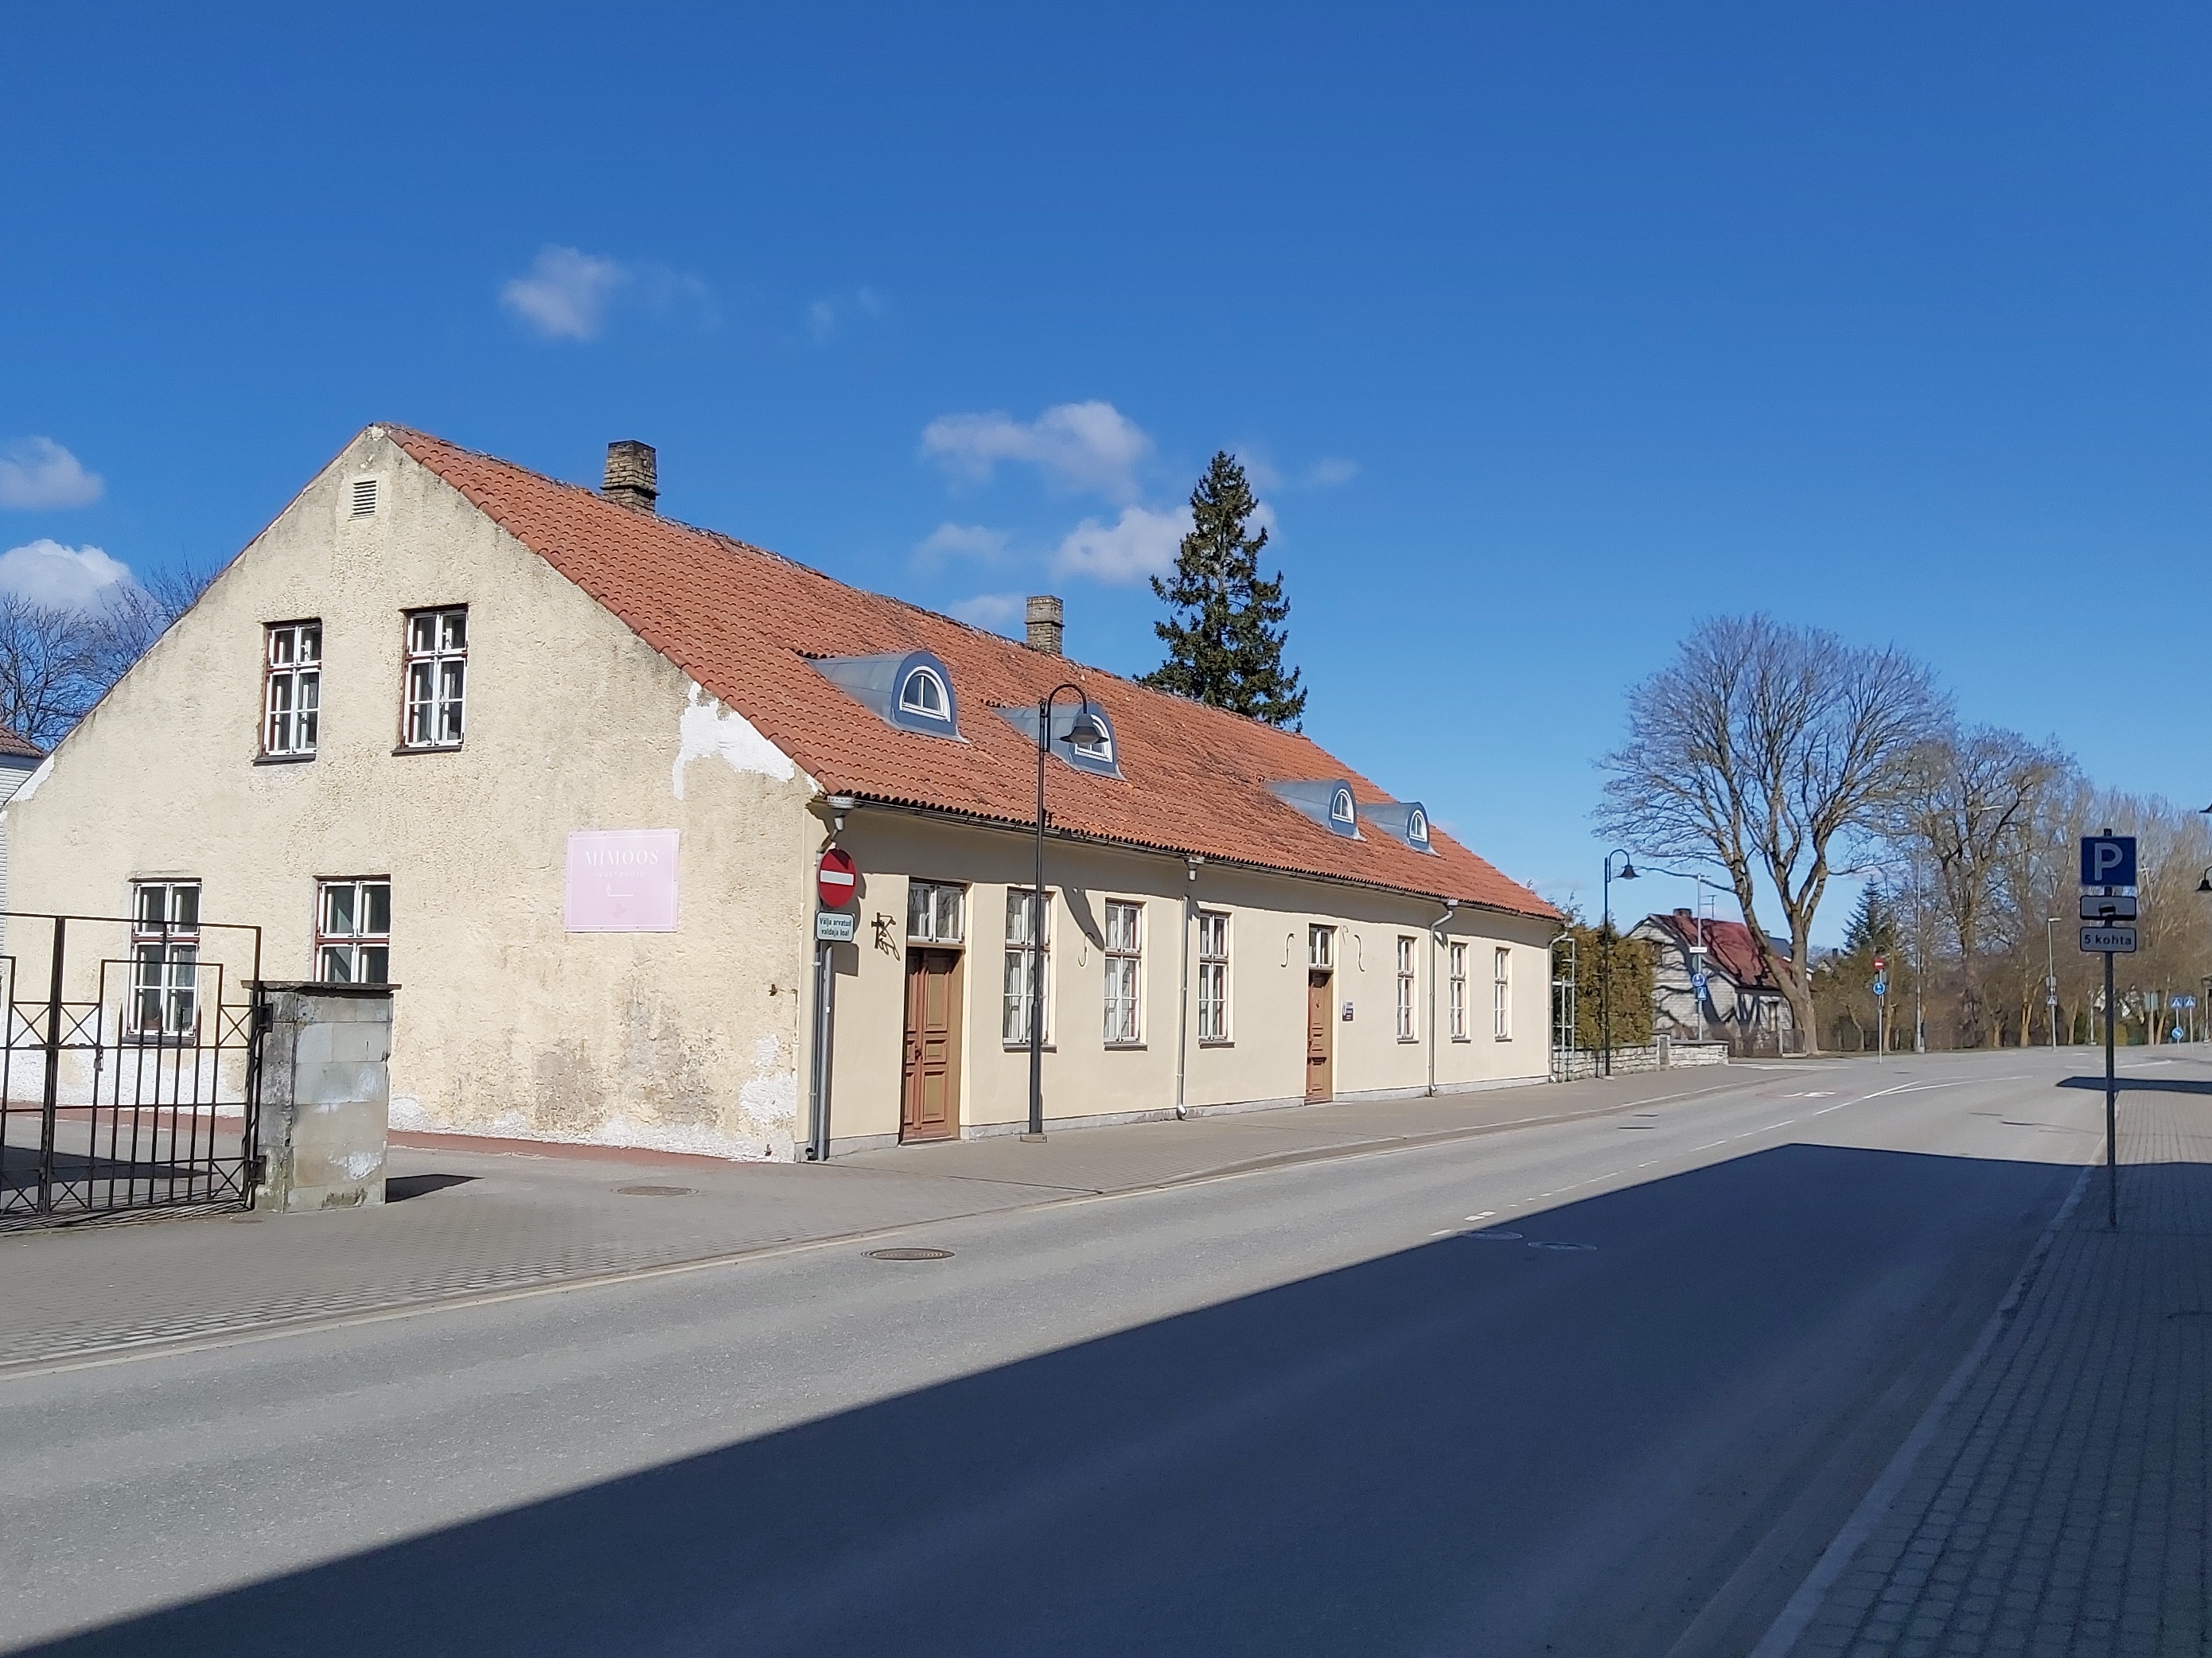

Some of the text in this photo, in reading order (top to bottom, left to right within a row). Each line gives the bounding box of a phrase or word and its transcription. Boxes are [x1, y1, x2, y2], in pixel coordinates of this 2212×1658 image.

[585, 848, 660, 866] MIMOOS
[2094, 843, 2124, 882] P
[2084, 934, 2132, 946] 5 kohta
